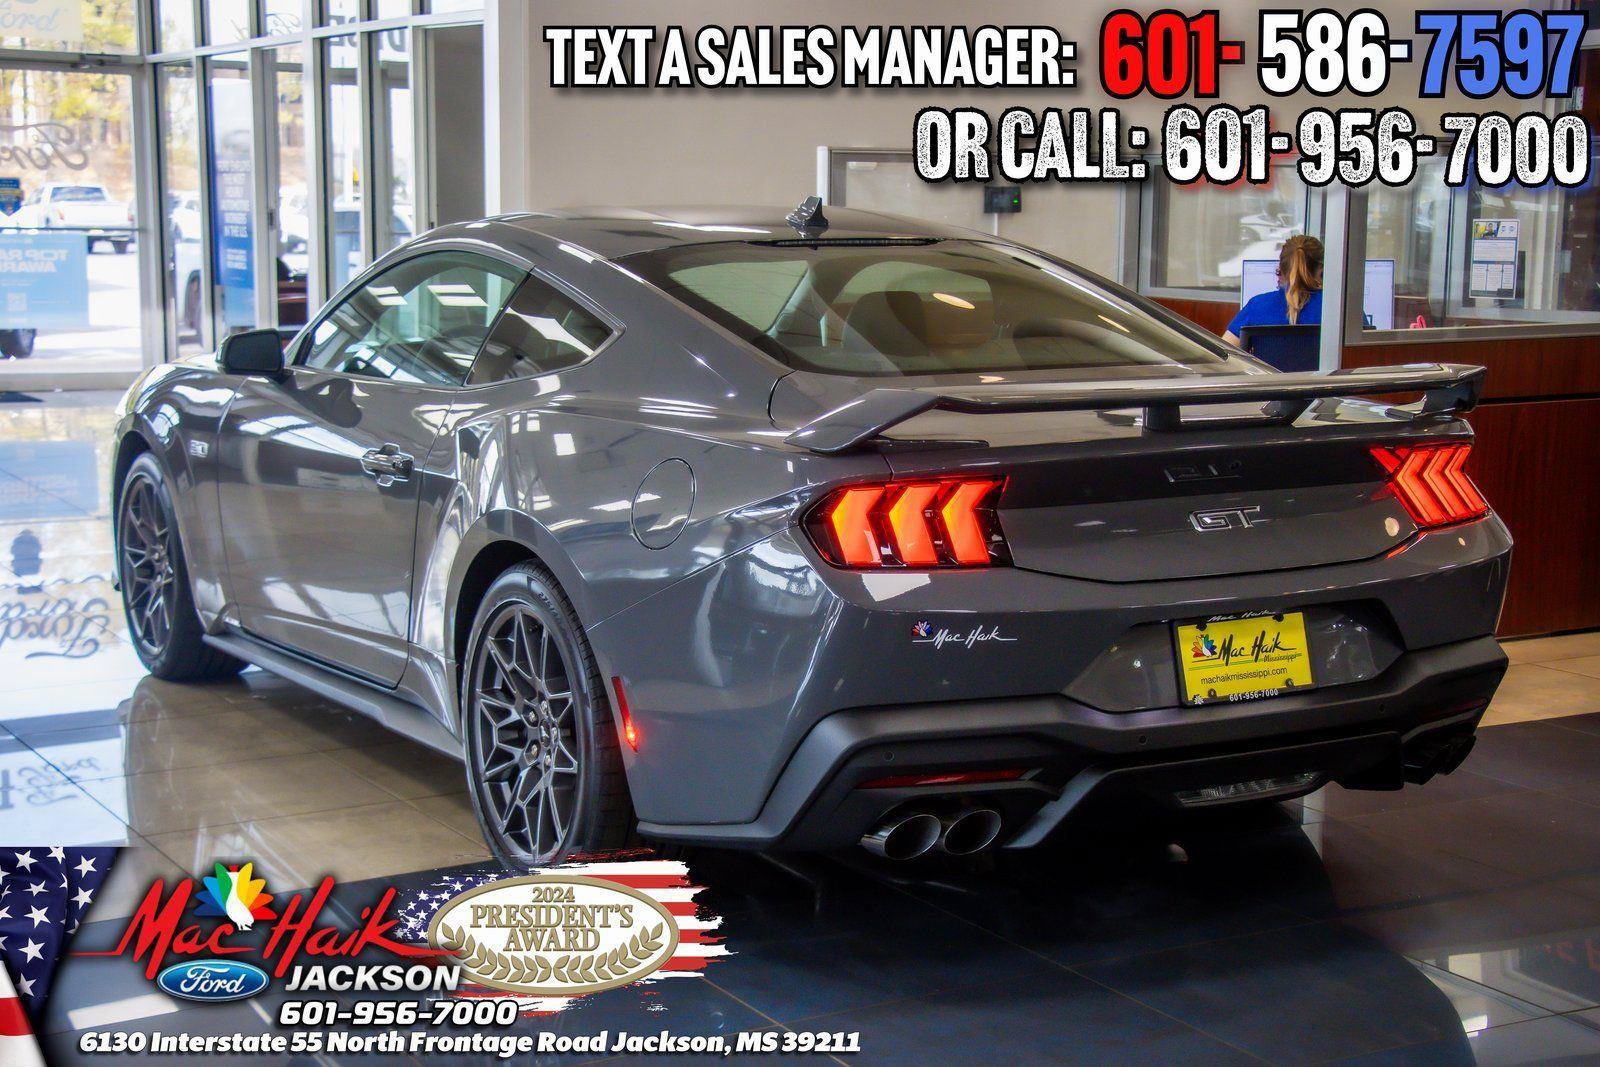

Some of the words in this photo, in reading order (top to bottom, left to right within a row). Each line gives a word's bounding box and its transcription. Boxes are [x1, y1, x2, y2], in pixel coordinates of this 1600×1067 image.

[1188, 505, 1261, 532] GT
[926, 628, 962, 650] Mac
[965, 625, 1009, 649] Haik
[1208, 633, 1250, 666] Mac
[1251, 630, 1293, 663] Haik
[1200, 667, 1288, 685] machaikmississippi.com
[1229, 688, 1279, 702] 601-956-7000
